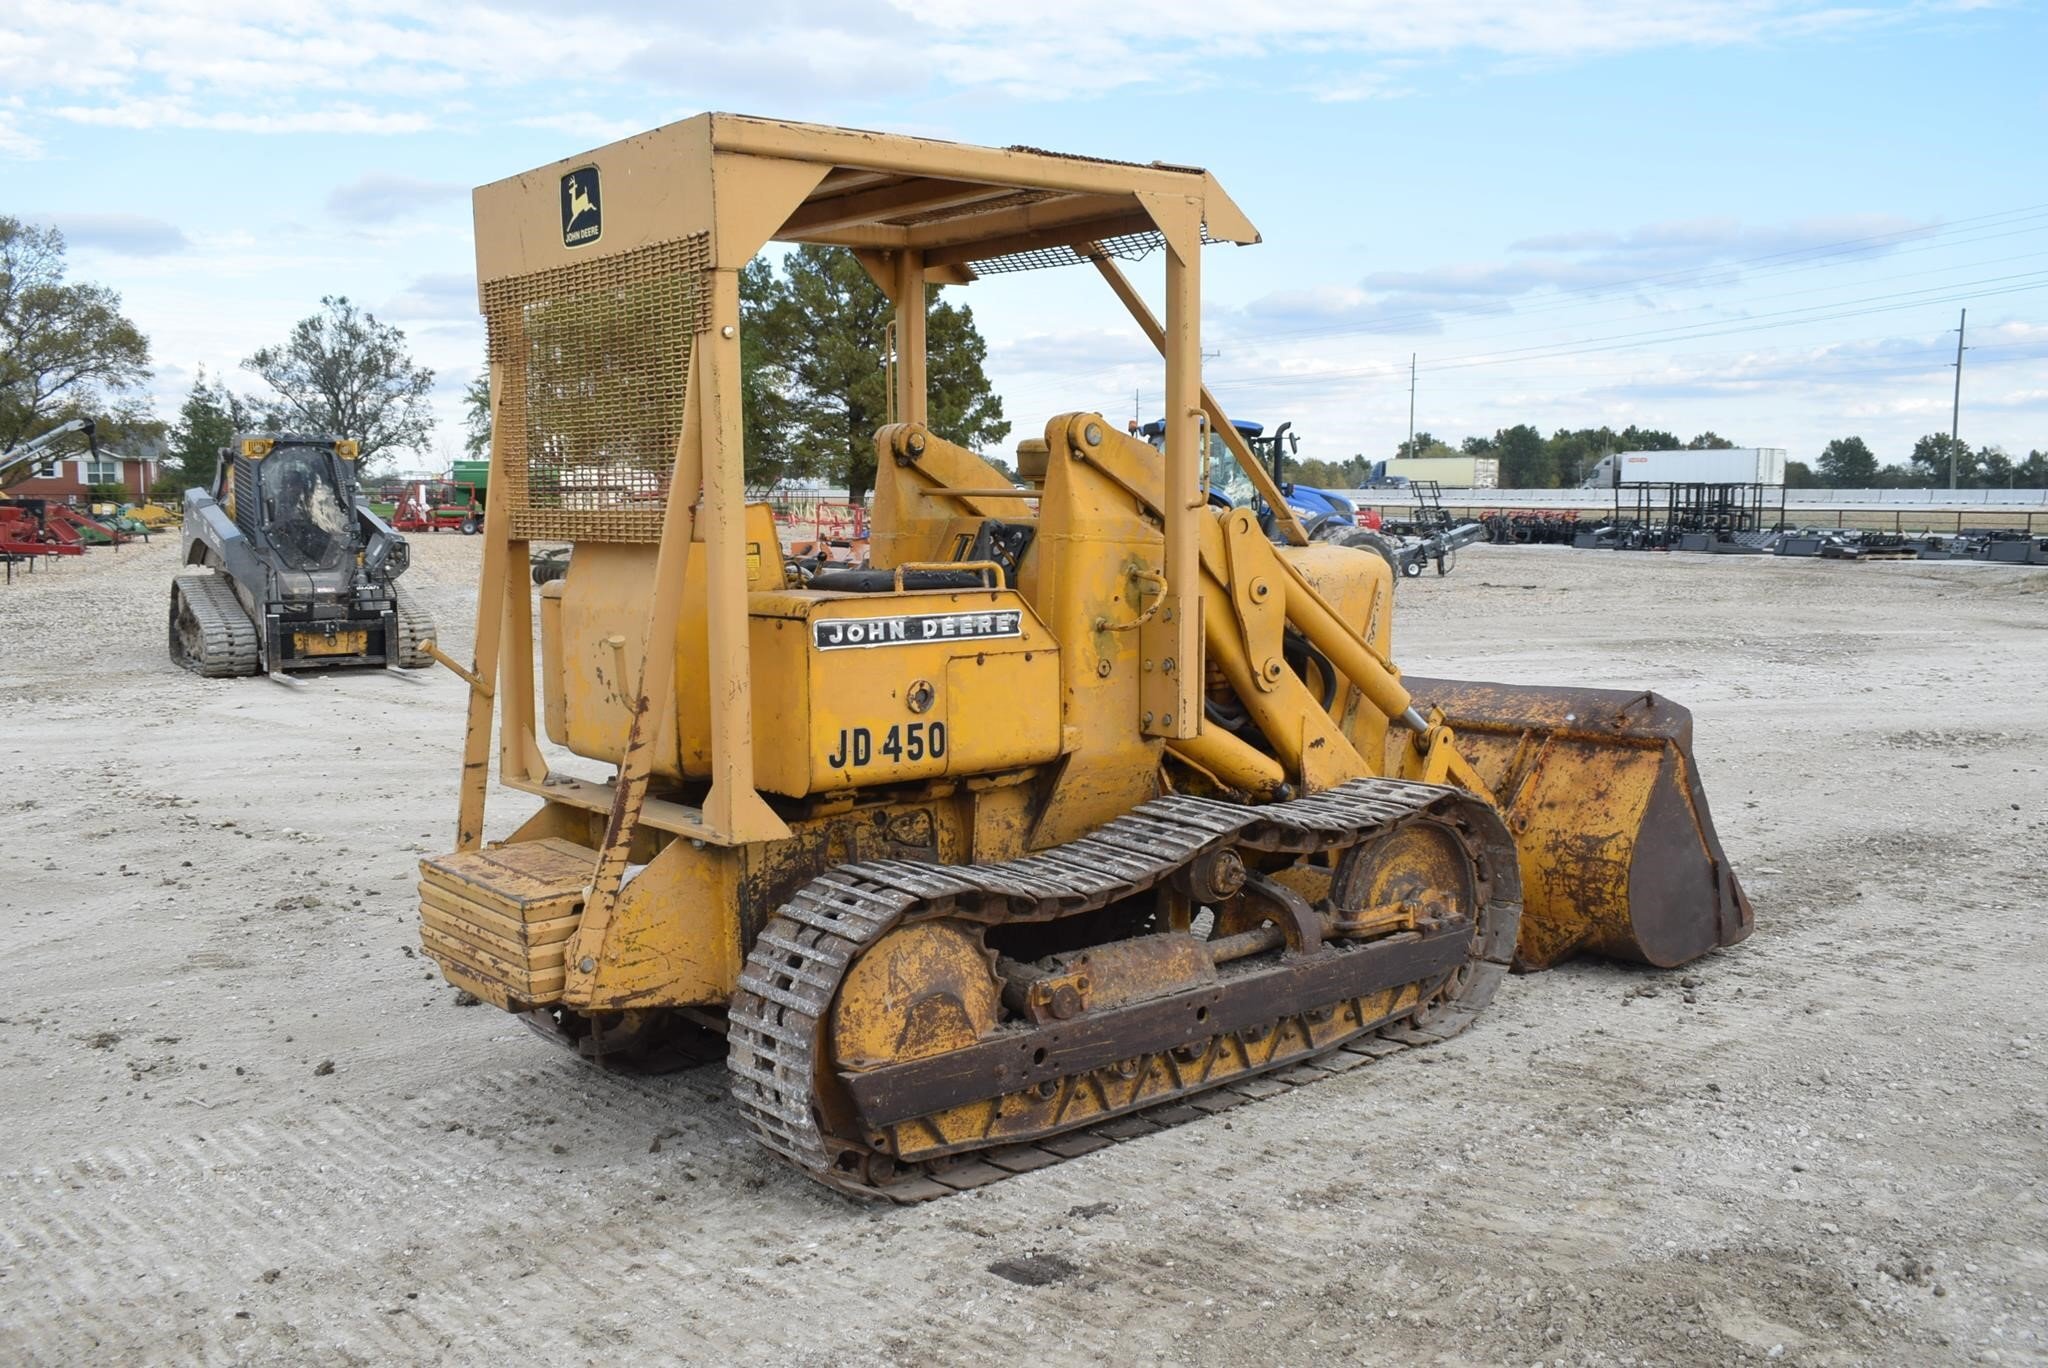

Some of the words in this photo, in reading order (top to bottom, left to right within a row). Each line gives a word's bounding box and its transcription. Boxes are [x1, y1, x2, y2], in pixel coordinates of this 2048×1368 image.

[566, 231, 580, 243] JOHN
[581, 225, 599, 239] DEERE
[829, 620, 905, 643] JOHN
[922, 613, 1012, 638] DEERE
[829, 727, 872, 768] JD
[883, 721, 945, 763] 450
